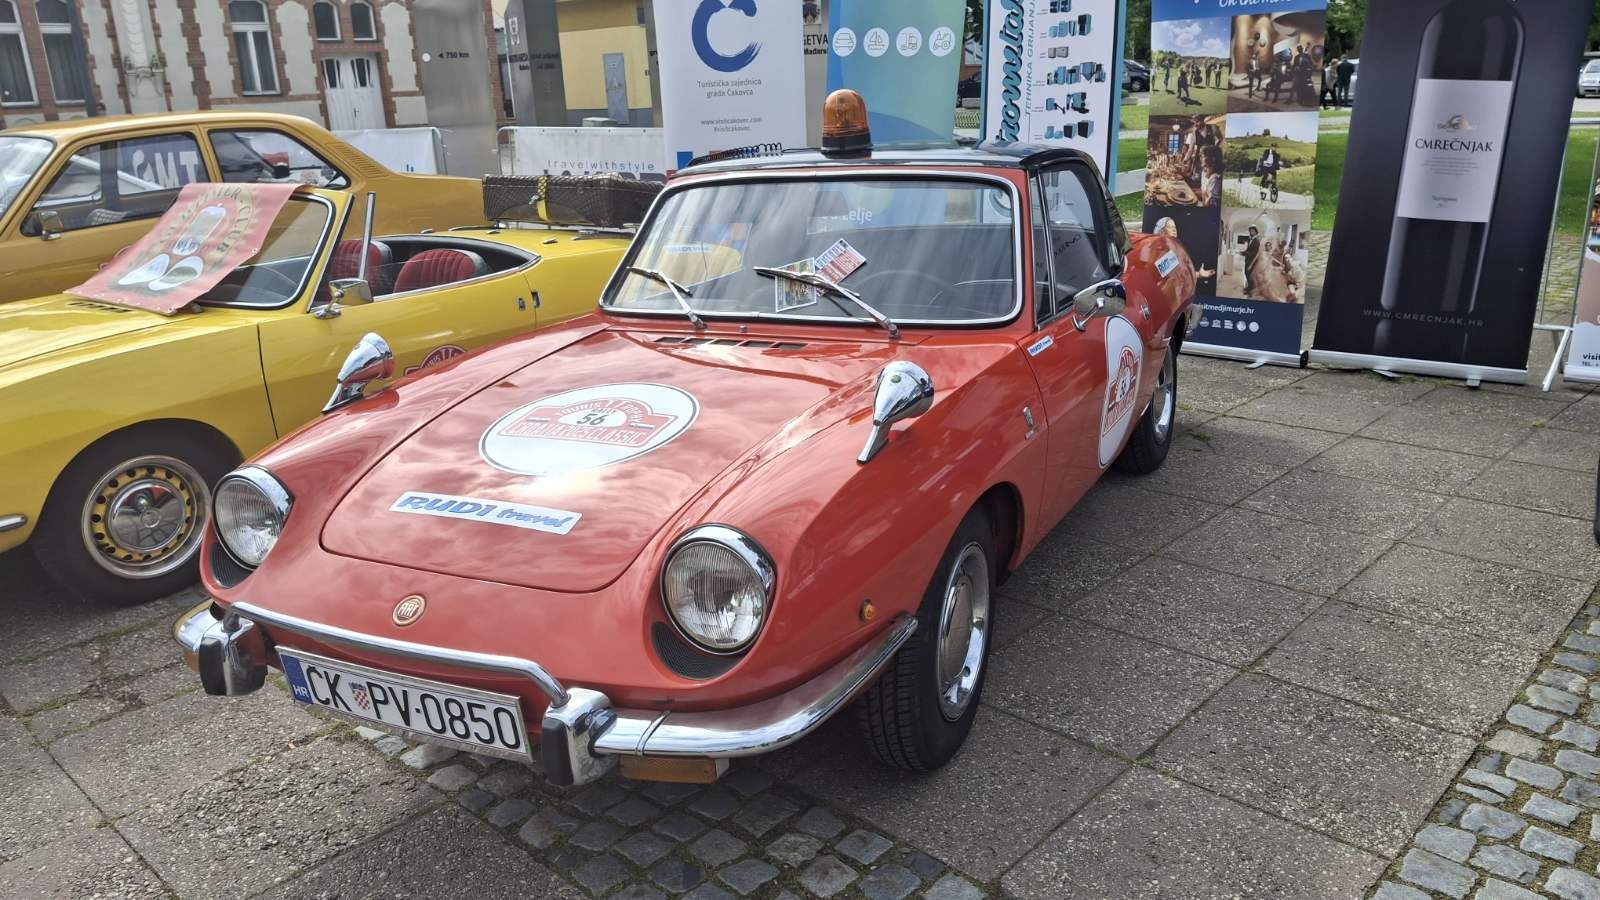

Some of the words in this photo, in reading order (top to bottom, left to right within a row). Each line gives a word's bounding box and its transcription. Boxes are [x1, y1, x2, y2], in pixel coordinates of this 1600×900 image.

[697, 79, 729, 89] Turistička
[730, 78, 762, 88] zajednica
[706, 90, 726, 99] grada
[726, 87, 754, 97] Čakovca
[1415, 137, 1493, 153] CMREČNJAK
[547, 159, 655, 173] travelwithstyle
[576, 413, 609, 426] 56
[396, 496, 498, 517] RUDI
[496, 508, 574, 528] travel
[293, 684, 310, 699] HR
[306, 665, 352, 712] ČK
